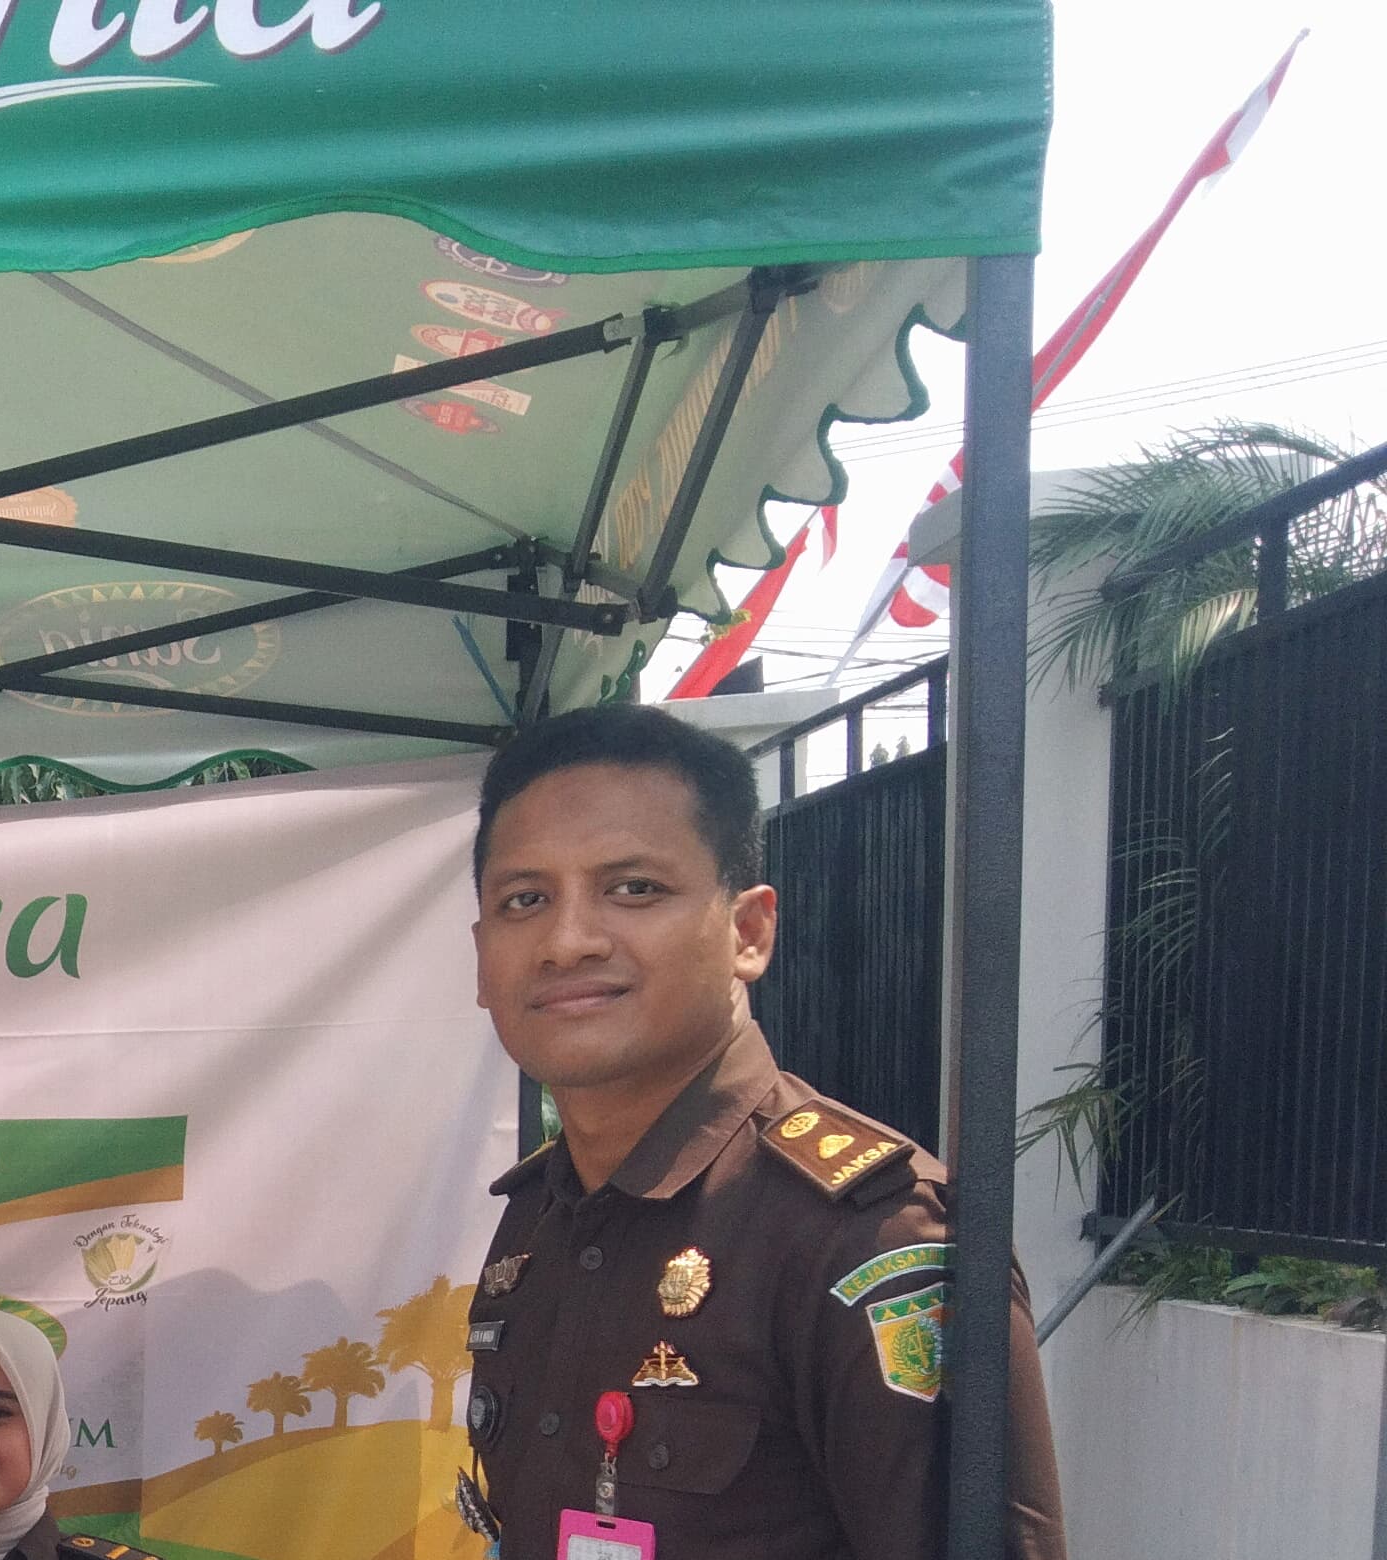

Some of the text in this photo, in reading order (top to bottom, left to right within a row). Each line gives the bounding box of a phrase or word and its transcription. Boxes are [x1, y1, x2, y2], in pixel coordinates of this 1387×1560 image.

[831, 1141, 898, 1185] JAKSA
[73, 1221, 116, 1250] Dengan
[84, 1288, 149, 1311] Jepang
